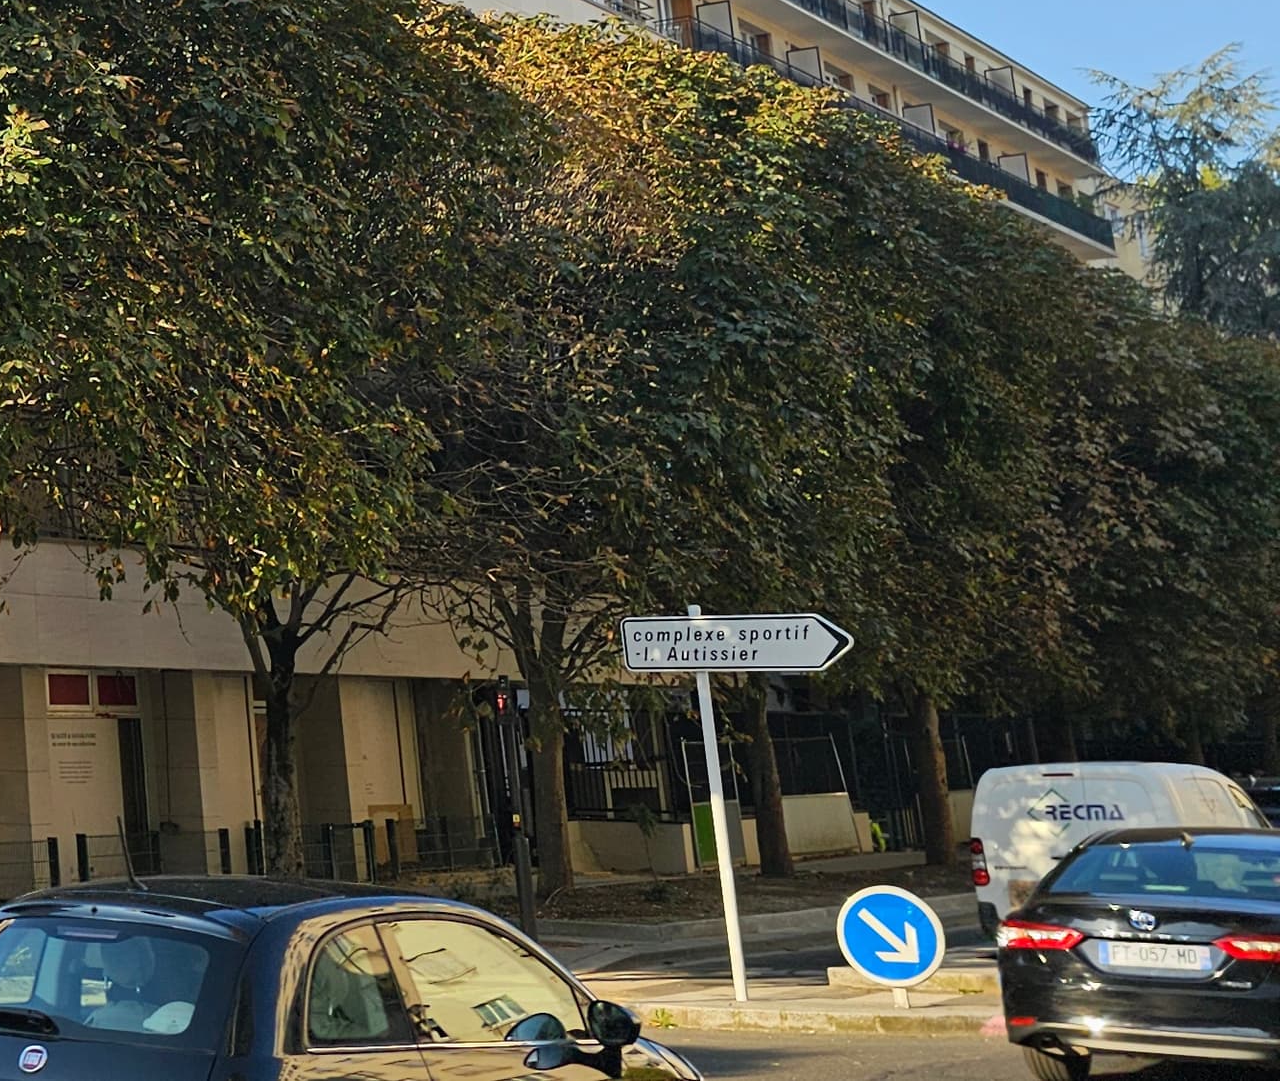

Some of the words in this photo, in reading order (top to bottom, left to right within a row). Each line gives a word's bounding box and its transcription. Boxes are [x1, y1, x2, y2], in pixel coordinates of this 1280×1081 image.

[633, 626, 725, 645] complexe
[738, 624, 809, 645] sportif
[666, 645, 758, 662] Autissier
[1045, 804, 1125, 821] RECMA
